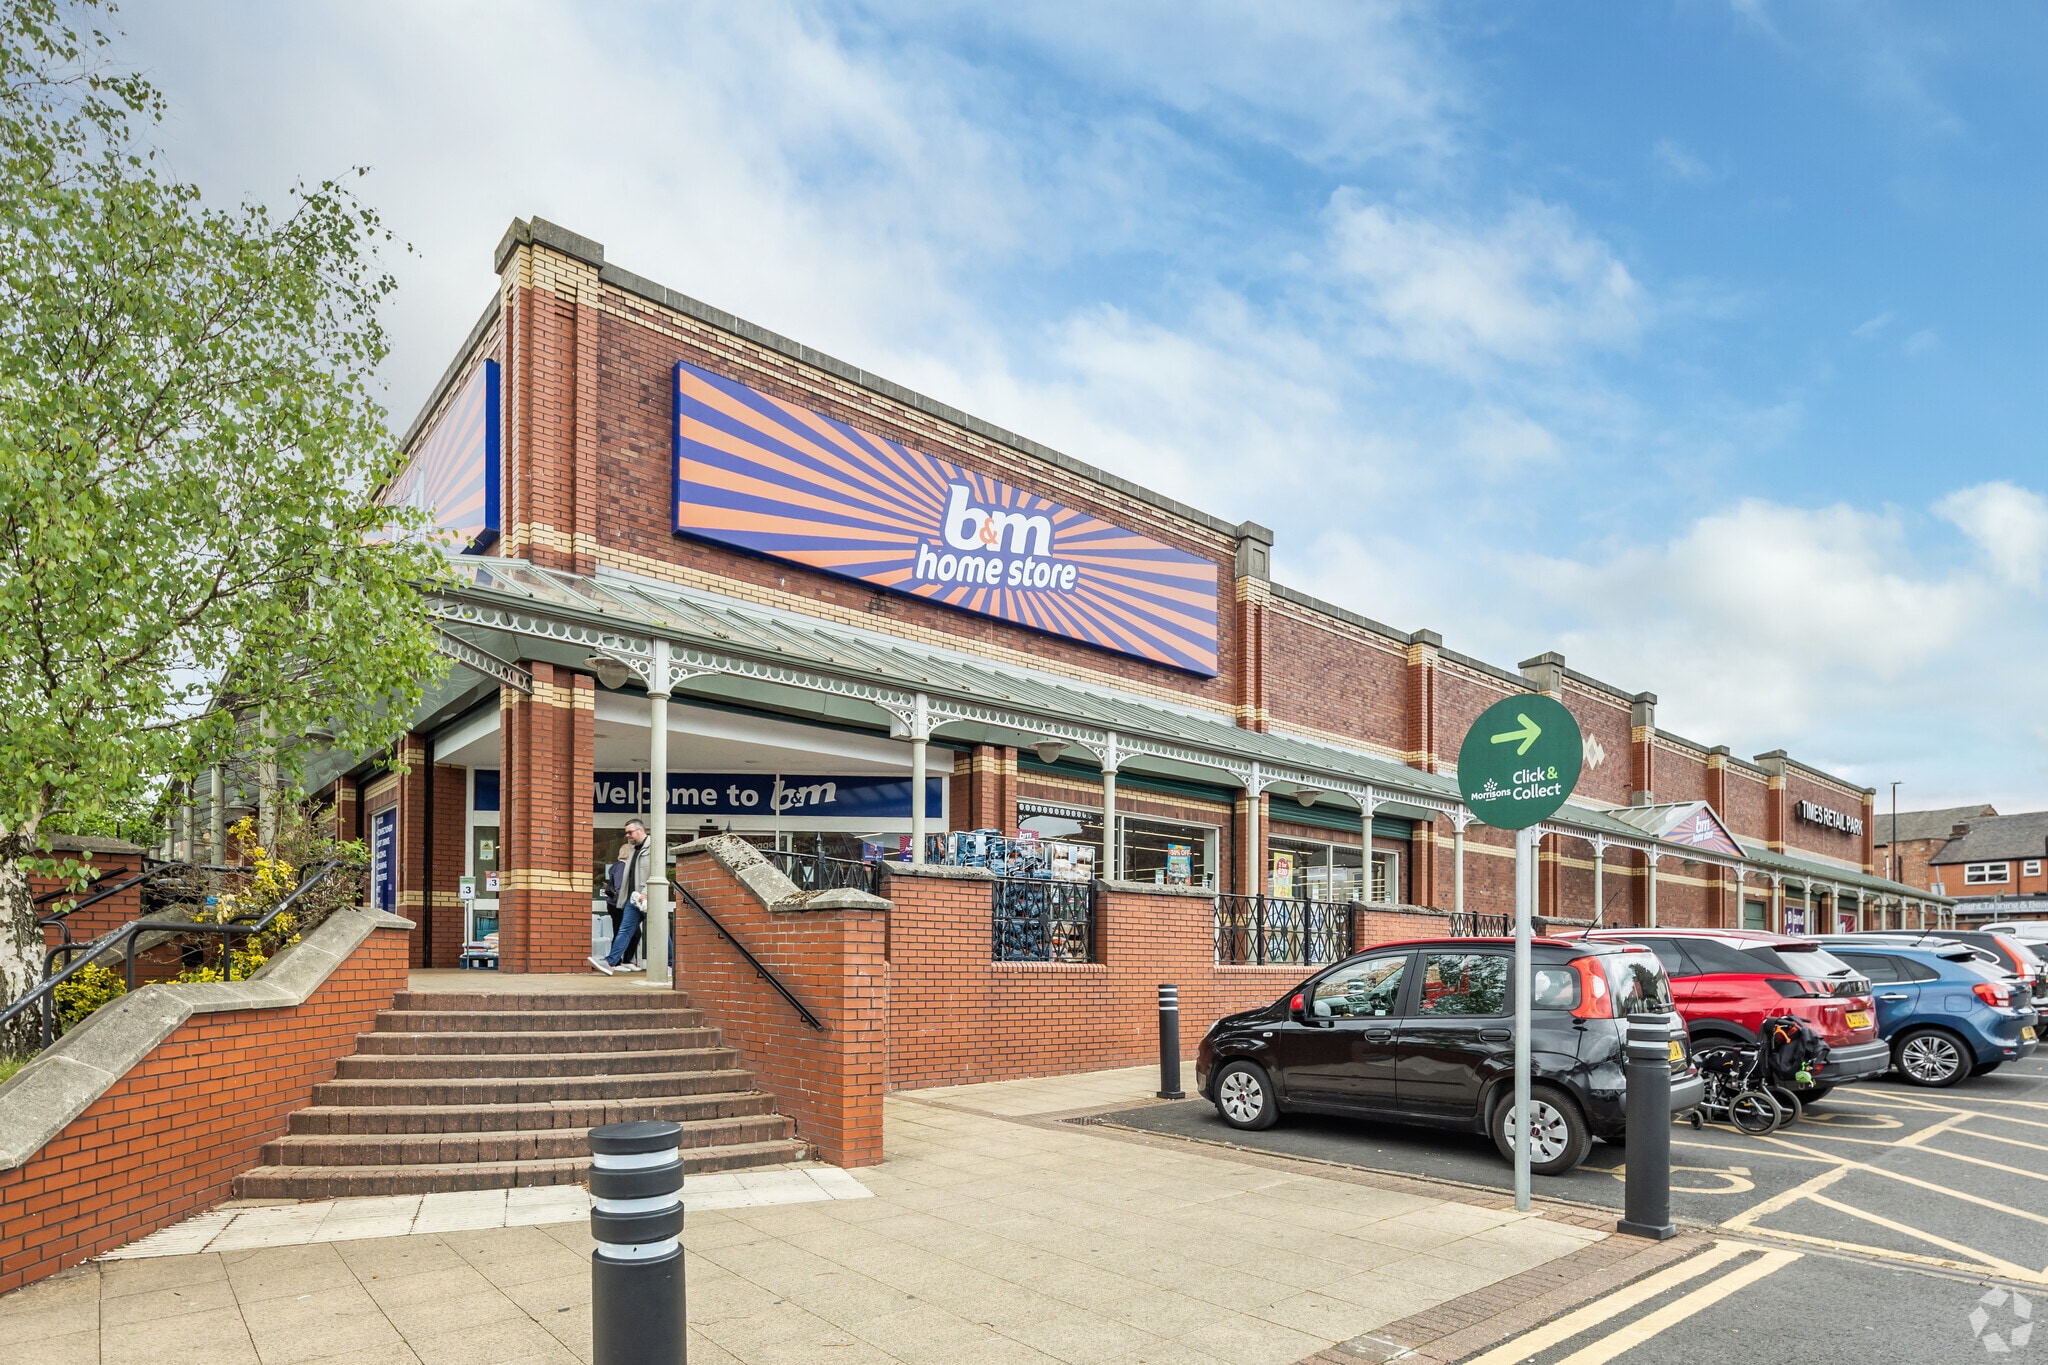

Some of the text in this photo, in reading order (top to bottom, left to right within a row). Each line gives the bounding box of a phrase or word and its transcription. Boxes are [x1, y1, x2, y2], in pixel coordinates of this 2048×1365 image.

[945, 483, 1052, 557] b&m
[916, 543, 1076, 590] home store
[1513, 766, 1558, 784] Click &
[727, 785, 759, 807] to
[770, 780, 837, 811] b&m
[1471, 789, 1511, 801] Morrisons
[1513, 783, 1561, 800] Collect
[1802, 800, 1863, 836] TIMES RETAIL PARK
